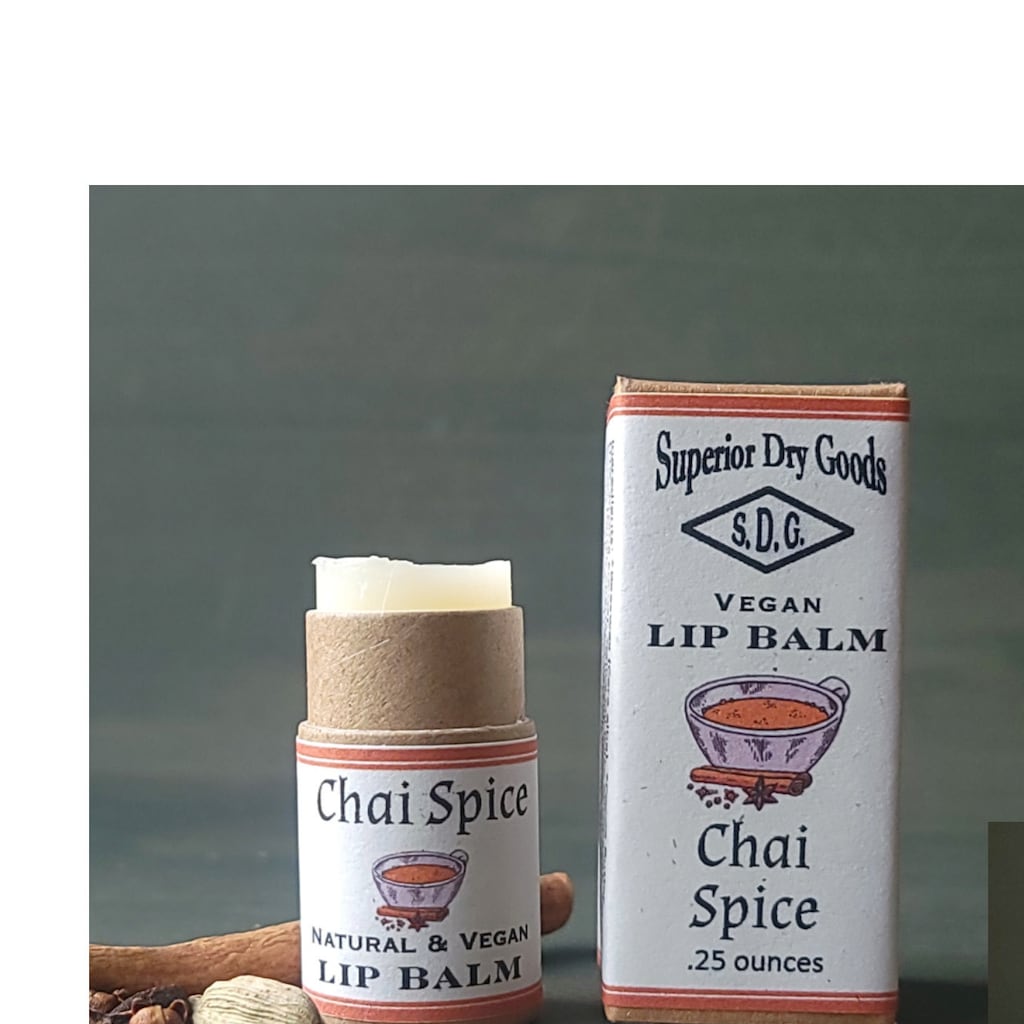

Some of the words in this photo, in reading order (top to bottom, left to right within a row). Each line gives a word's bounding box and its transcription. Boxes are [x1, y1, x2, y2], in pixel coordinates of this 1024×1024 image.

[655, 430, 755, 496] Superior
[761, 432, 809, 480] Dry
[814, 434, 887, 496] Goods
[647, 623, 729, 648] LIP
[747, 625, 888, 652] BALM
[316, 775, 414, 825] Chai
[425, 776, 529, 835] Spice
[697, 814, 810, 869] Chai
[689, 884, 819, 941] Spice
[427, 935, 448, 952] &
[687, 950, 726, 971] .25
[734, 953, 824, 973] ounces
[318, 959, 381, 989] LIP
[399, 955, 523, 991] BALM
